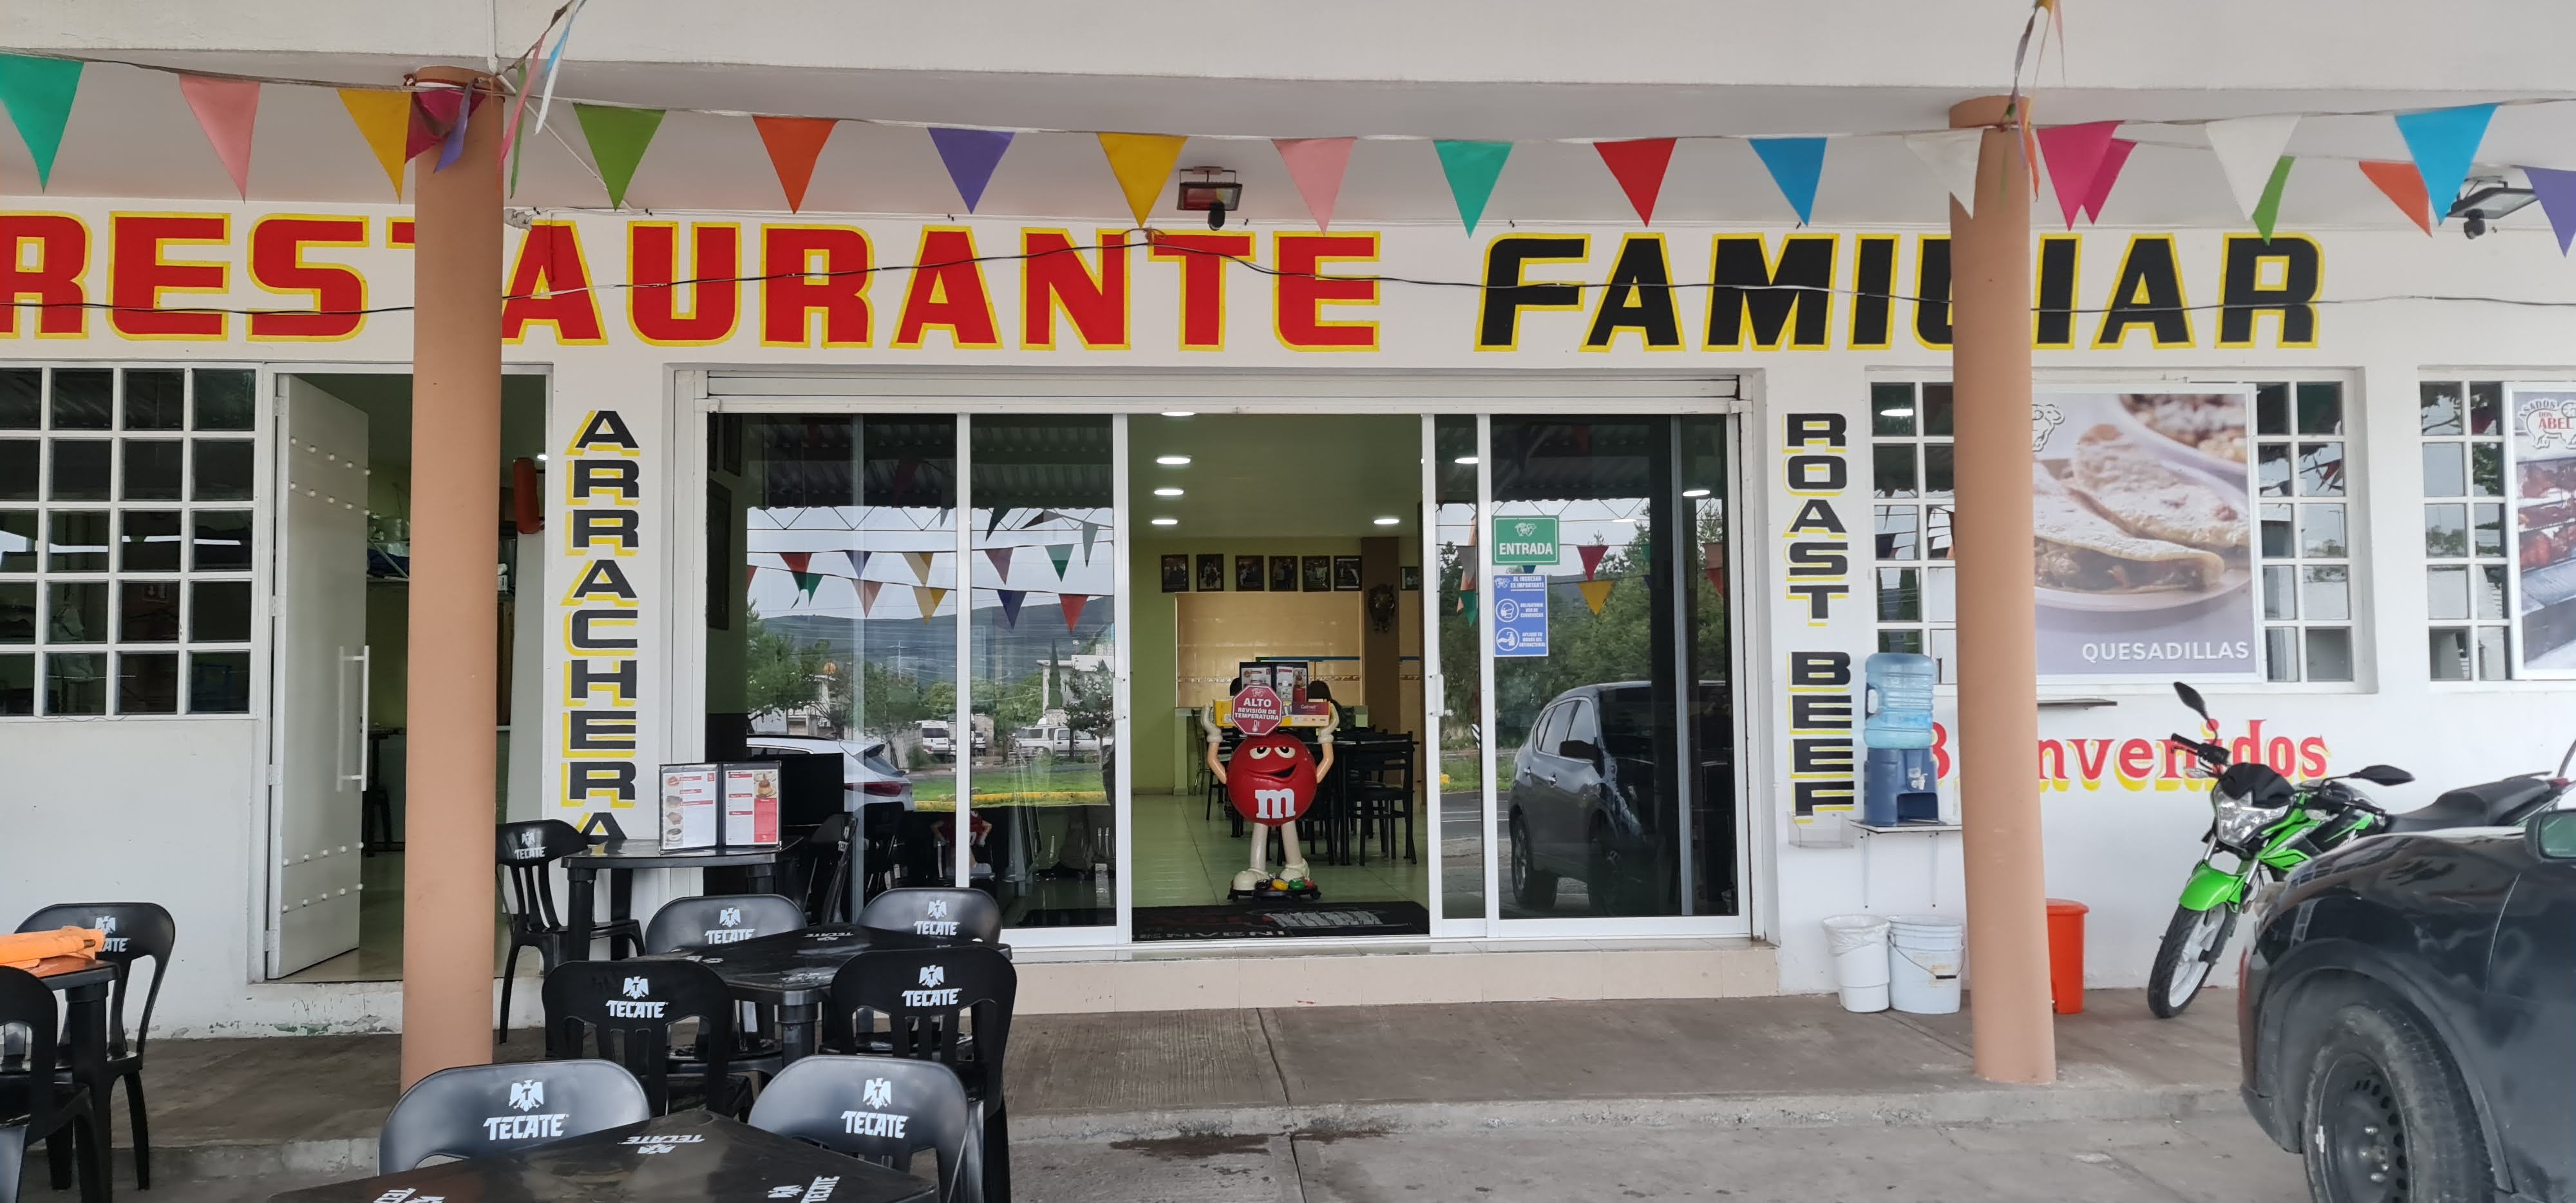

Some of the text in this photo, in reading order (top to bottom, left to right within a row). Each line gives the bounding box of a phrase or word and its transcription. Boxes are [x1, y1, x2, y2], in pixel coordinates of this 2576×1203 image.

[0, 210, 1380, 352] RESAURANTE
[2539, 417, 2574, 430] ABEL
[1499, 542, 1553, 555] ENTRADA
[1781, 412, 1855, 825] ROAST BEEF
[2082, 641, 2249, 663] QUESADILLAS
[1243, 697, 1272, 707] ALTO
[1255, 789, 1296, 819] m
[514, 846, 547, 860] TECATE
[705, 928, 755, 945] TECATE
[913, 920, 961, 936] TECATE
[902, 988, 962, 1007] TECATE
[605, 999, 667, 1018] TECATE
[482, 1113, 569, 1141] TECATE
[840, 1110, 909, 1139] TECATE
[617, 1134, 705, 1144] TECATE
